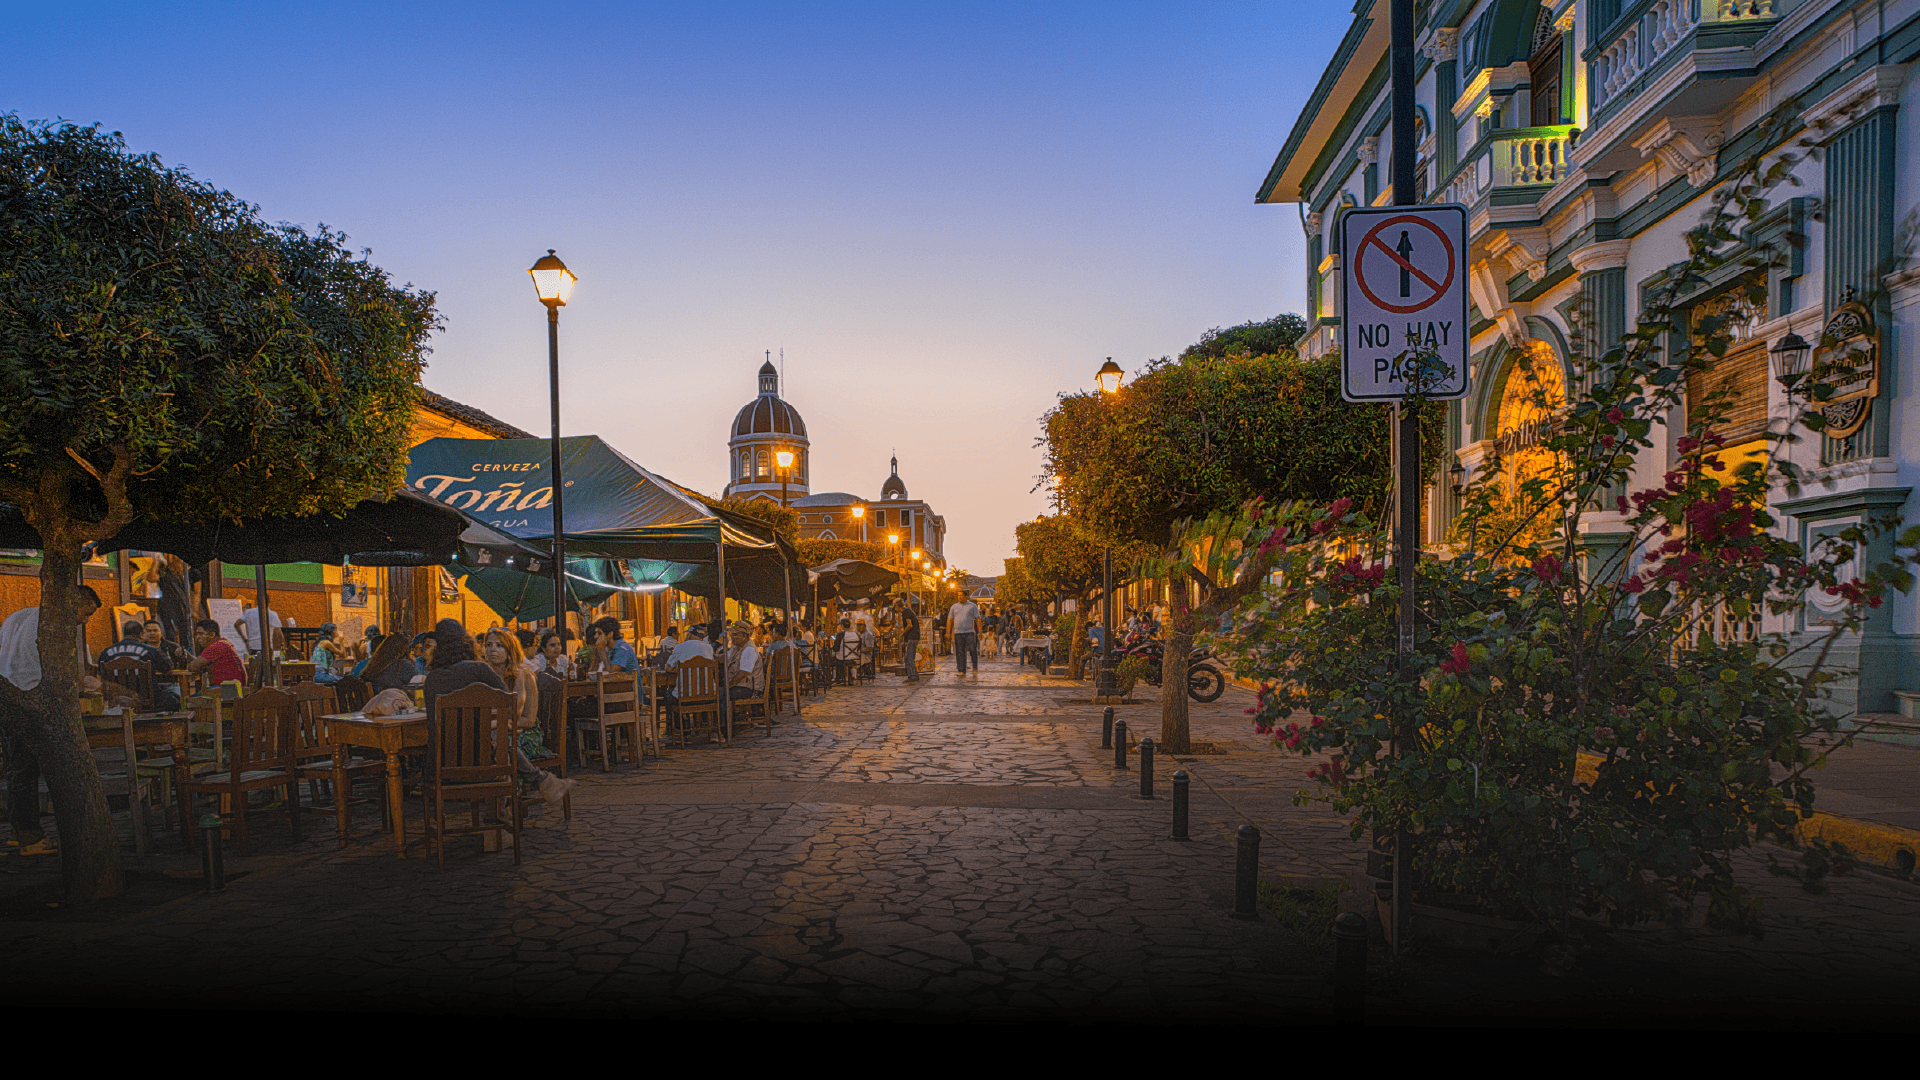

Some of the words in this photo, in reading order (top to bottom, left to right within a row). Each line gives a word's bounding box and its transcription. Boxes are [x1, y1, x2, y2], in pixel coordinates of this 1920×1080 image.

[1358, 323, 1390, 349] NO
[1406, 321, 1453, 347] HAY
[1374, 357, 1434, 384] PAS
[471, 462, 541, 472] CERVEZA
[414, 474, 553, 512] Toña
